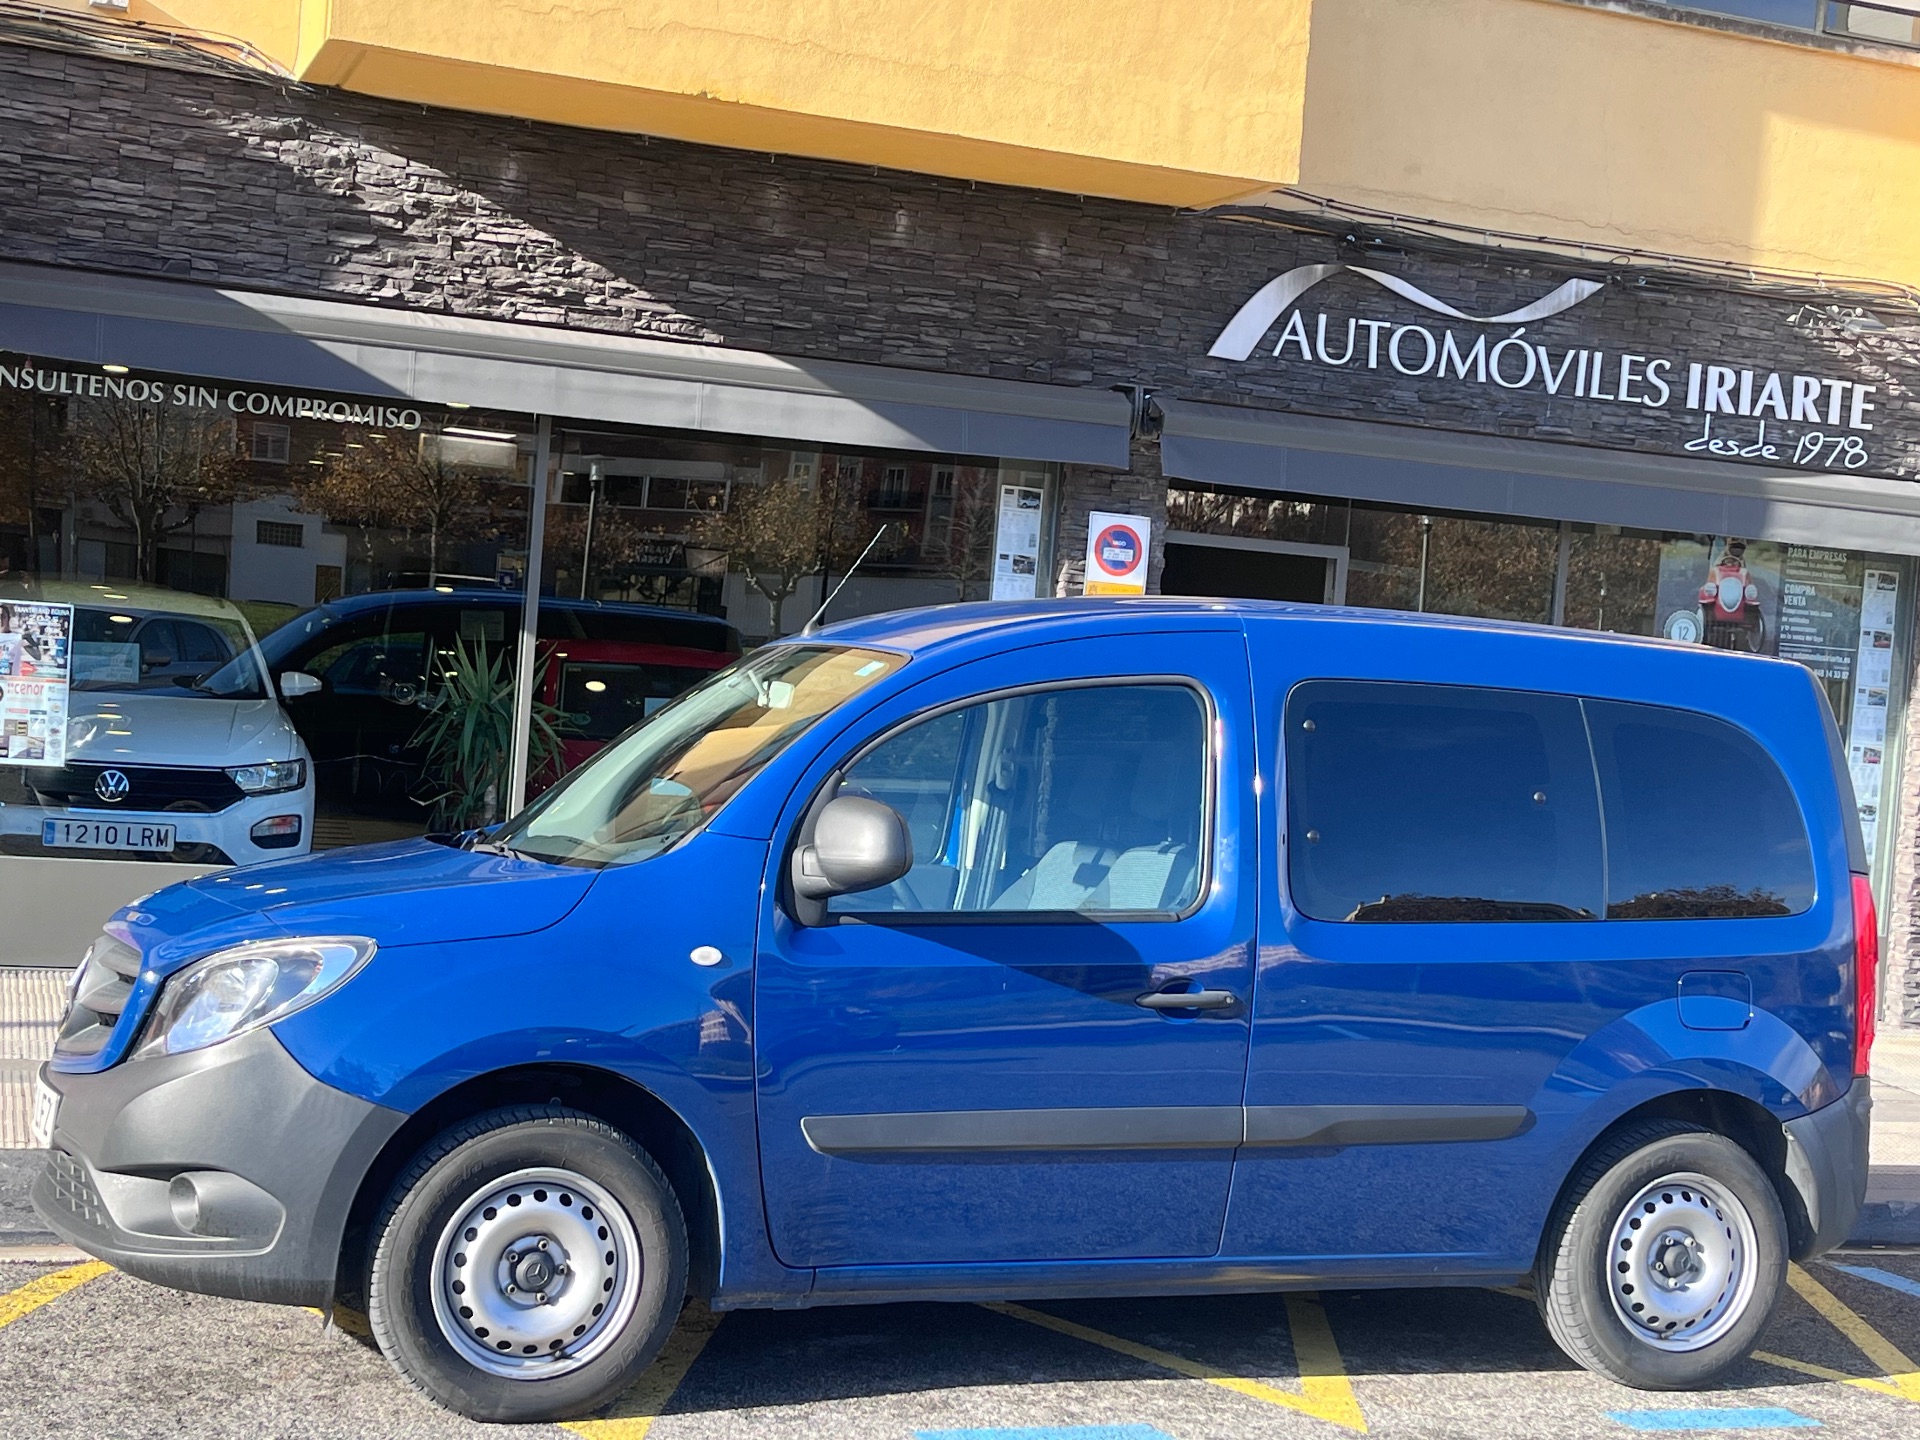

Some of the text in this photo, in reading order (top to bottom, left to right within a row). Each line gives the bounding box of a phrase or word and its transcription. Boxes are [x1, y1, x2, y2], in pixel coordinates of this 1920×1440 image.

[1272, 308, 1877, 431] AUTOMÓVILES IRIARTE
[173, 384, 218, 409] SIN
[227, 390, 422, 430] COMPROMISO
[1684, 412, 1869, 469] desde 1978
[1787, 547, 1848, 563] PARA EMPRESAS
[1784, 583, 1816, 596] COMPRA
[1783, 594, 1807, 607] VENTA
[1677, 625, 1690, 641] 12
[14, 682, 45, 696] cenor
[64, 822, 170, 848] 1210 LRM
